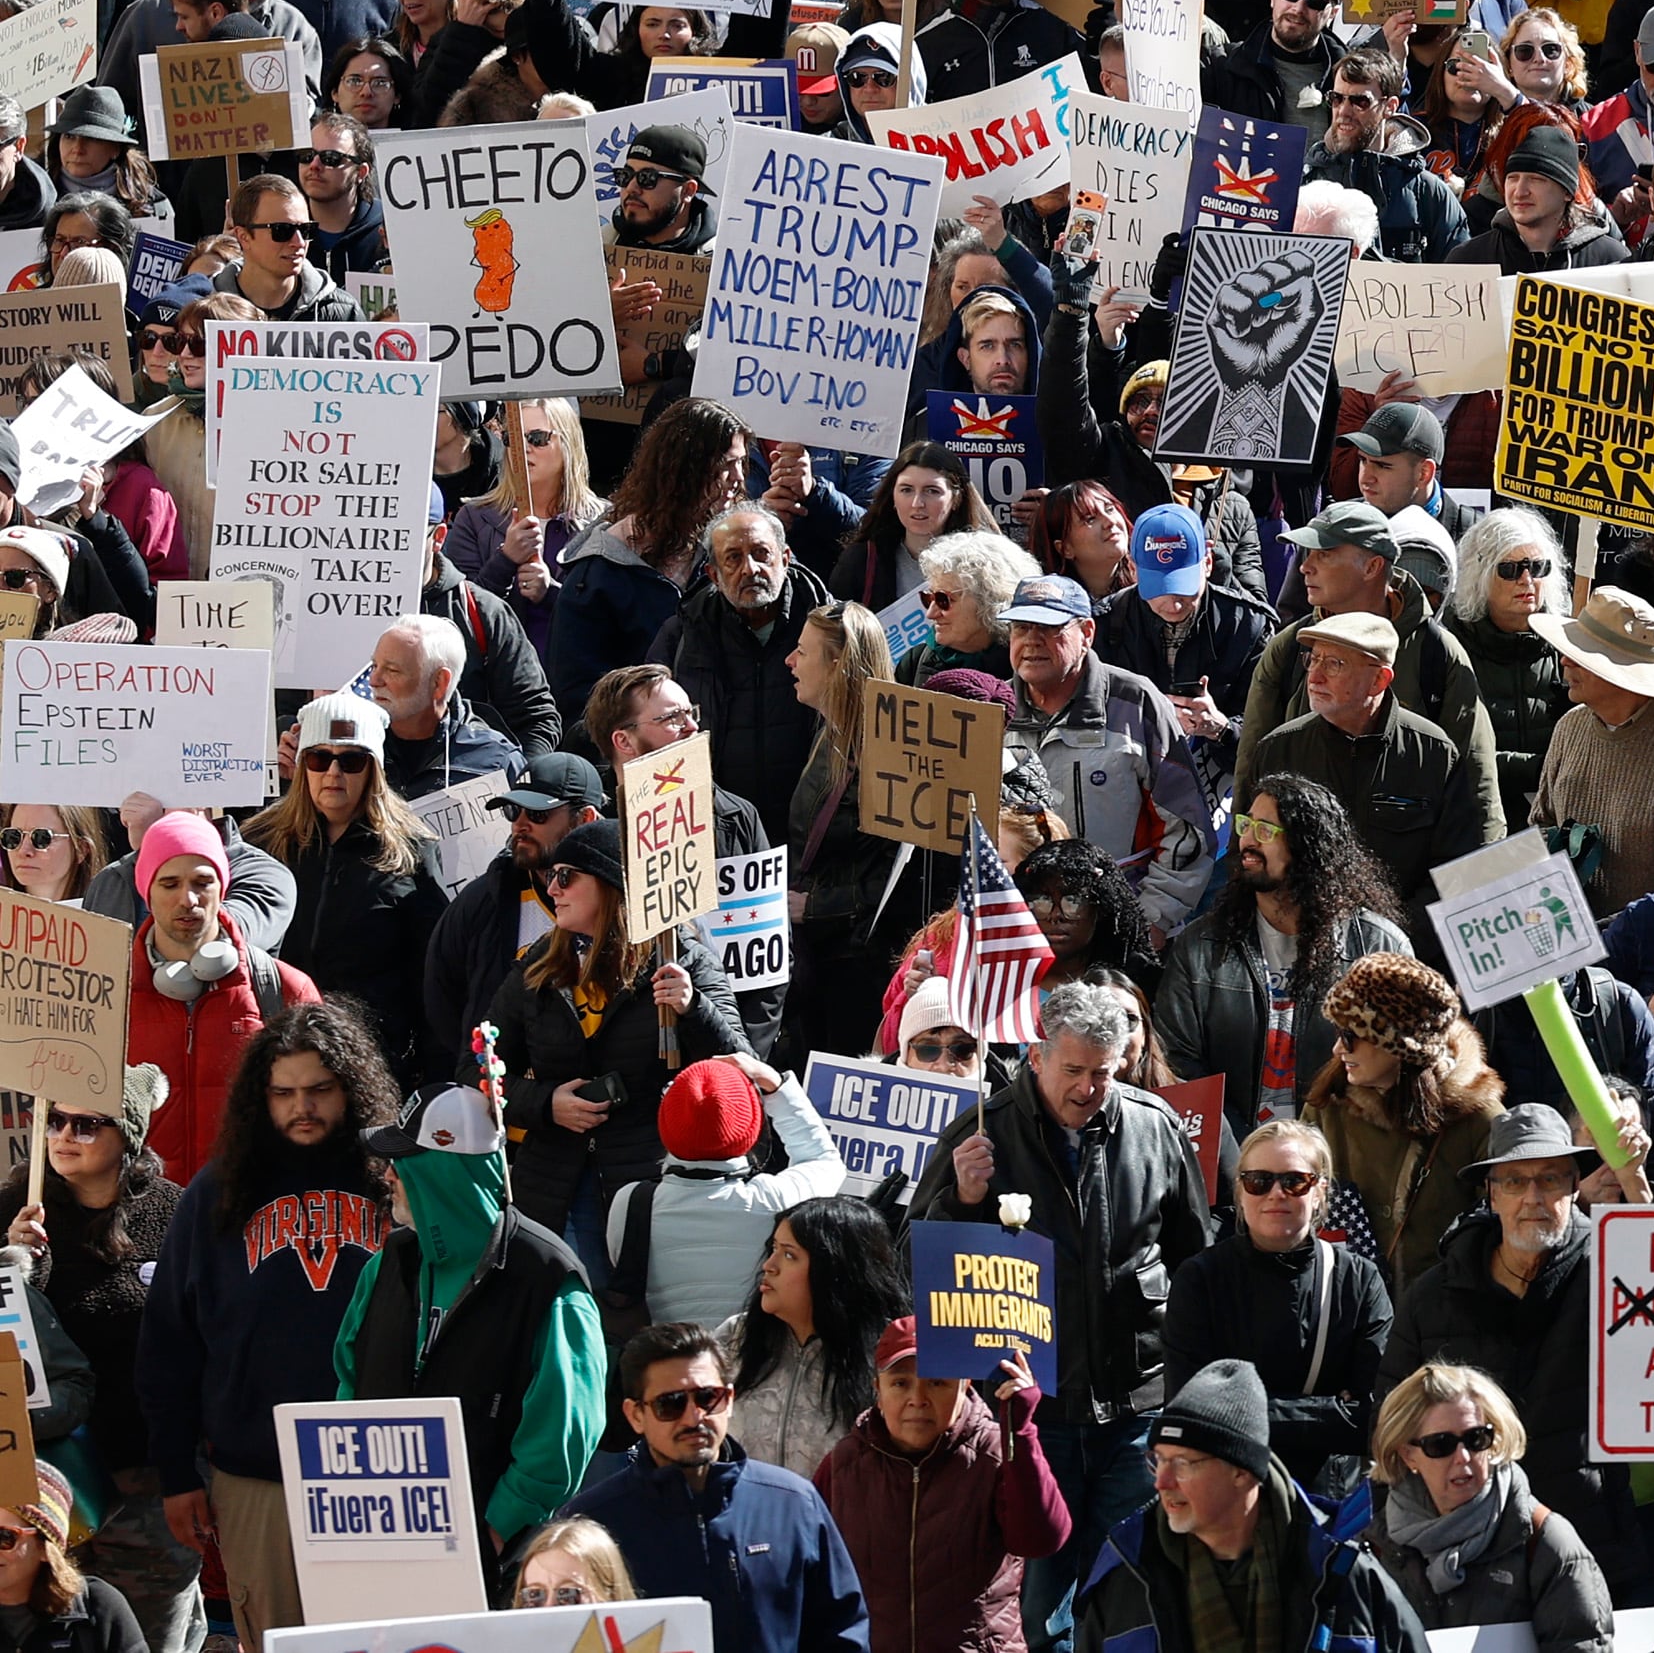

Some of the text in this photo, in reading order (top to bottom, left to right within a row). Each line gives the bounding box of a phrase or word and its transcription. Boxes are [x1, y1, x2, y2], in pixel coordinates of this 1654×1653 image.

[385, 144, 586, 209] CHEETO
[17, 647, 214, 695] OPERATION
[18, 695, 155, 730] EPSTEIN
[875, 697, 976, 758] MELT
[15, 731, 118, 766] FILES
[903, 750, 944, 779] THE
[635, 804, 705, 856] REAL
[875, 777, 965, 840] ICE
[645, 842, 698, 882] EPIC
[643, 872, 703, 921] FURY
[955, 1254, 1039, 1299] PROTECT
[930, 1292, 1052, 1341] IMMIGRANTS
[317, 1425, 428, 1475] ICE OUT!
[401, 1485, 452, 1533] ICE!
